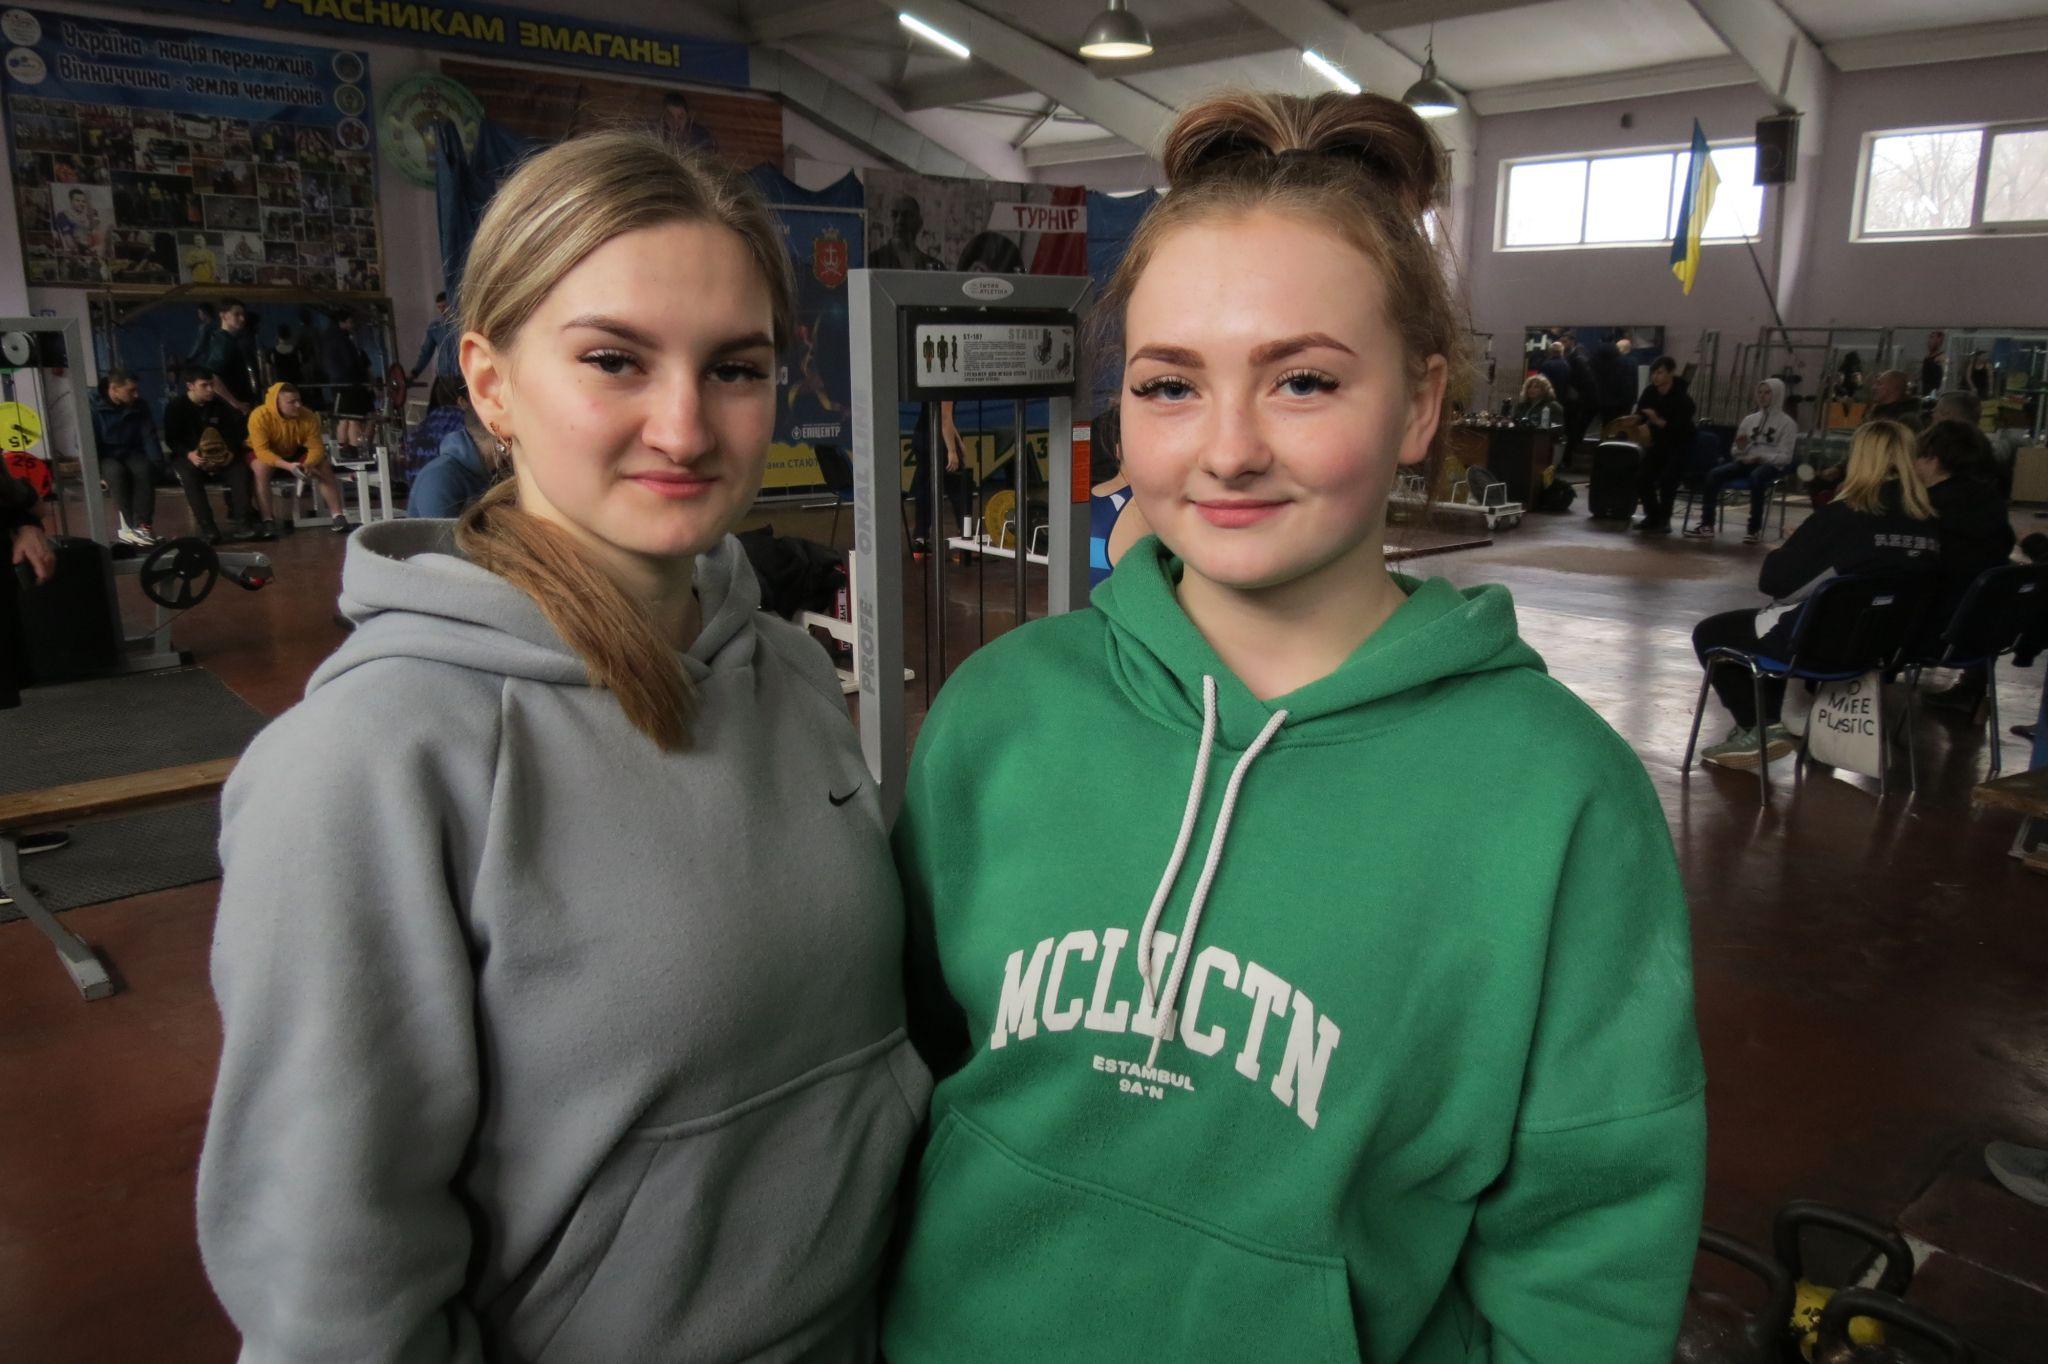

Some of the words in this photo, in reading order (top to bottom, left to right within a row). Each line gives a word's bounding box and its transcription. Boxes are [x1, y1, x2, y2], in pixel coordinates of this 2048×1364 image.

[62, 23, 143, 54] Україна
[158, 40, 208, 64] нація
[211, 48, 316, 77] переможців
[519, 20, 681, 68] ЗМАГАНЬ!
[58, 54, 171, 90] Вінниччина
[185, 76, 239, 98] земля
[243, 83, 324, 106] чемпіонів
[1012, 206, 1081, 231] ТУРНІР
[802, 425, 841, 439] ЕПІЦЕНТР
[1817, 709, 1875, 736] PLASTIC
[1092, 1054, 1195, 1092] ESTAMBUL
